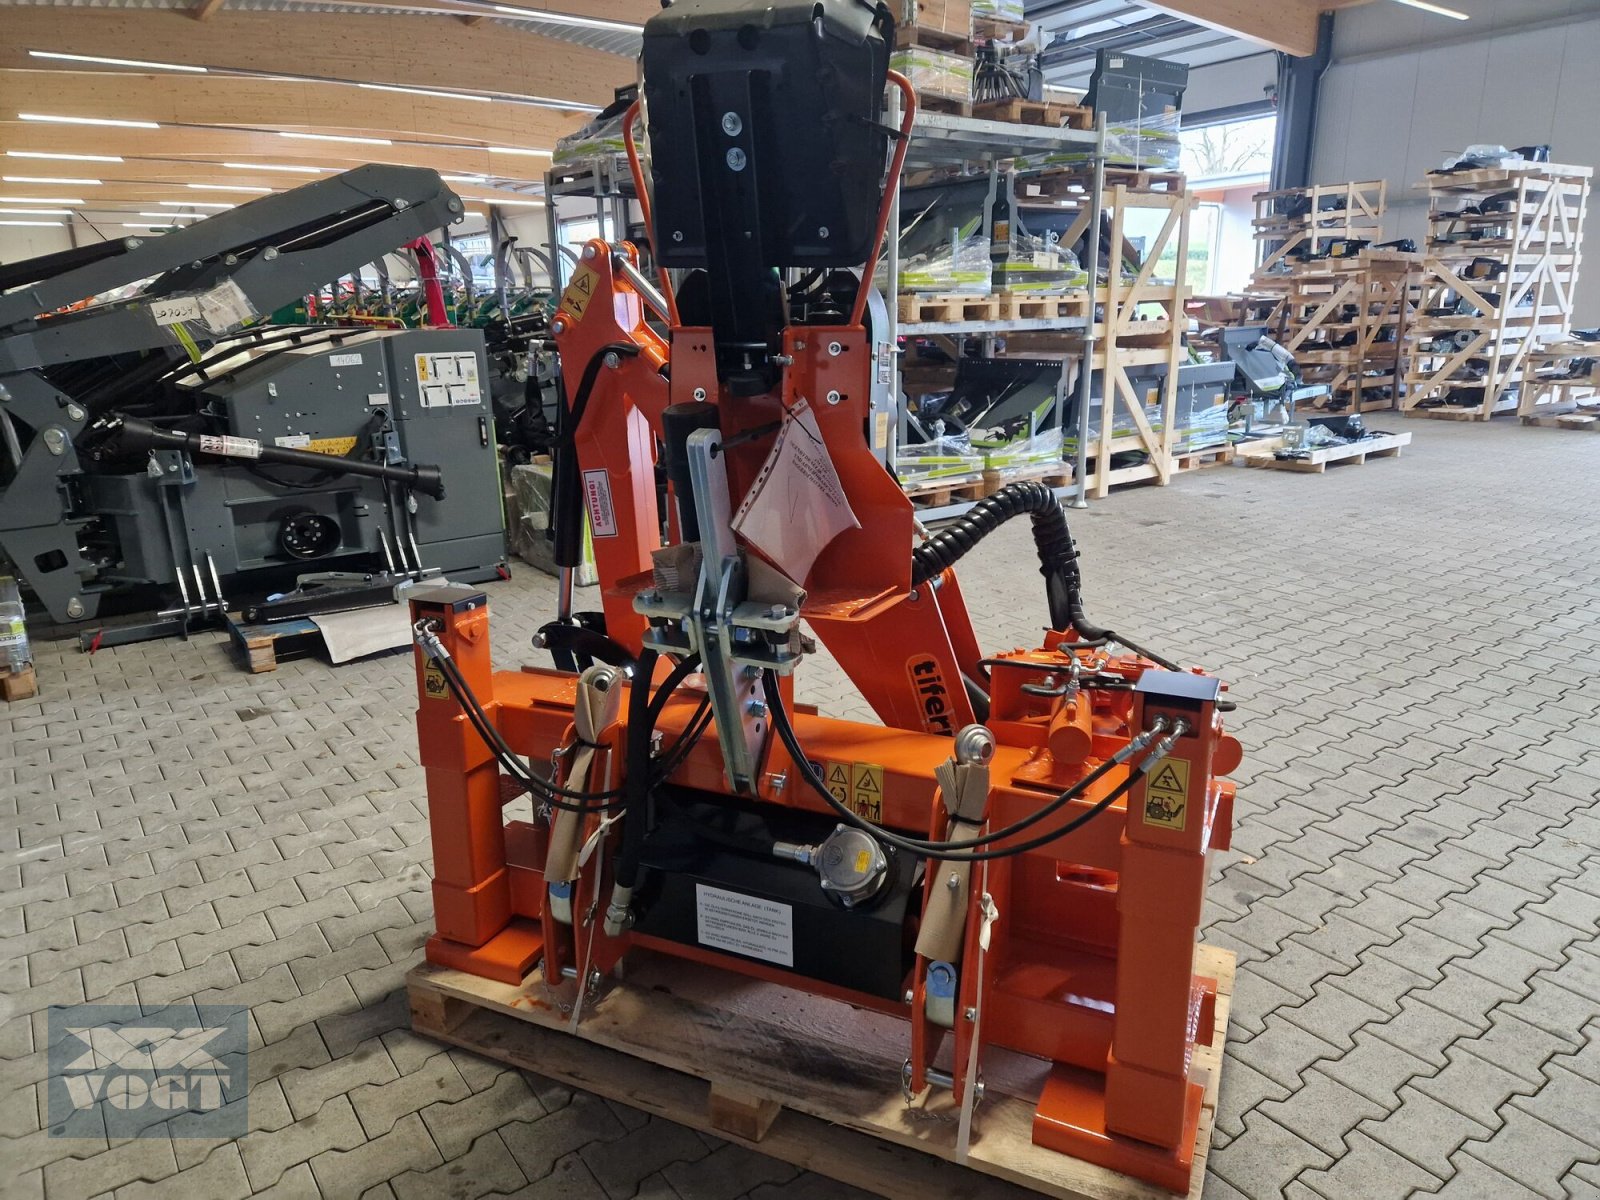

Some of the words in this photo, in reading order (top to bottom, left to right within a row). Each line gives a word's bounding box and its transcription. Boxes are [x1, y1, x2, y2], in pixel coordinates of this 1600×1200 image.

[588, 480, 602, 527] ACHTUNG!
[913, 660, 953, 736] tifer
[703, 891, 740, 905] HYDRAULISCHE
[742, 901, 761, 911] ANLAGE
[763, 906, 782, 915] (TANK)
